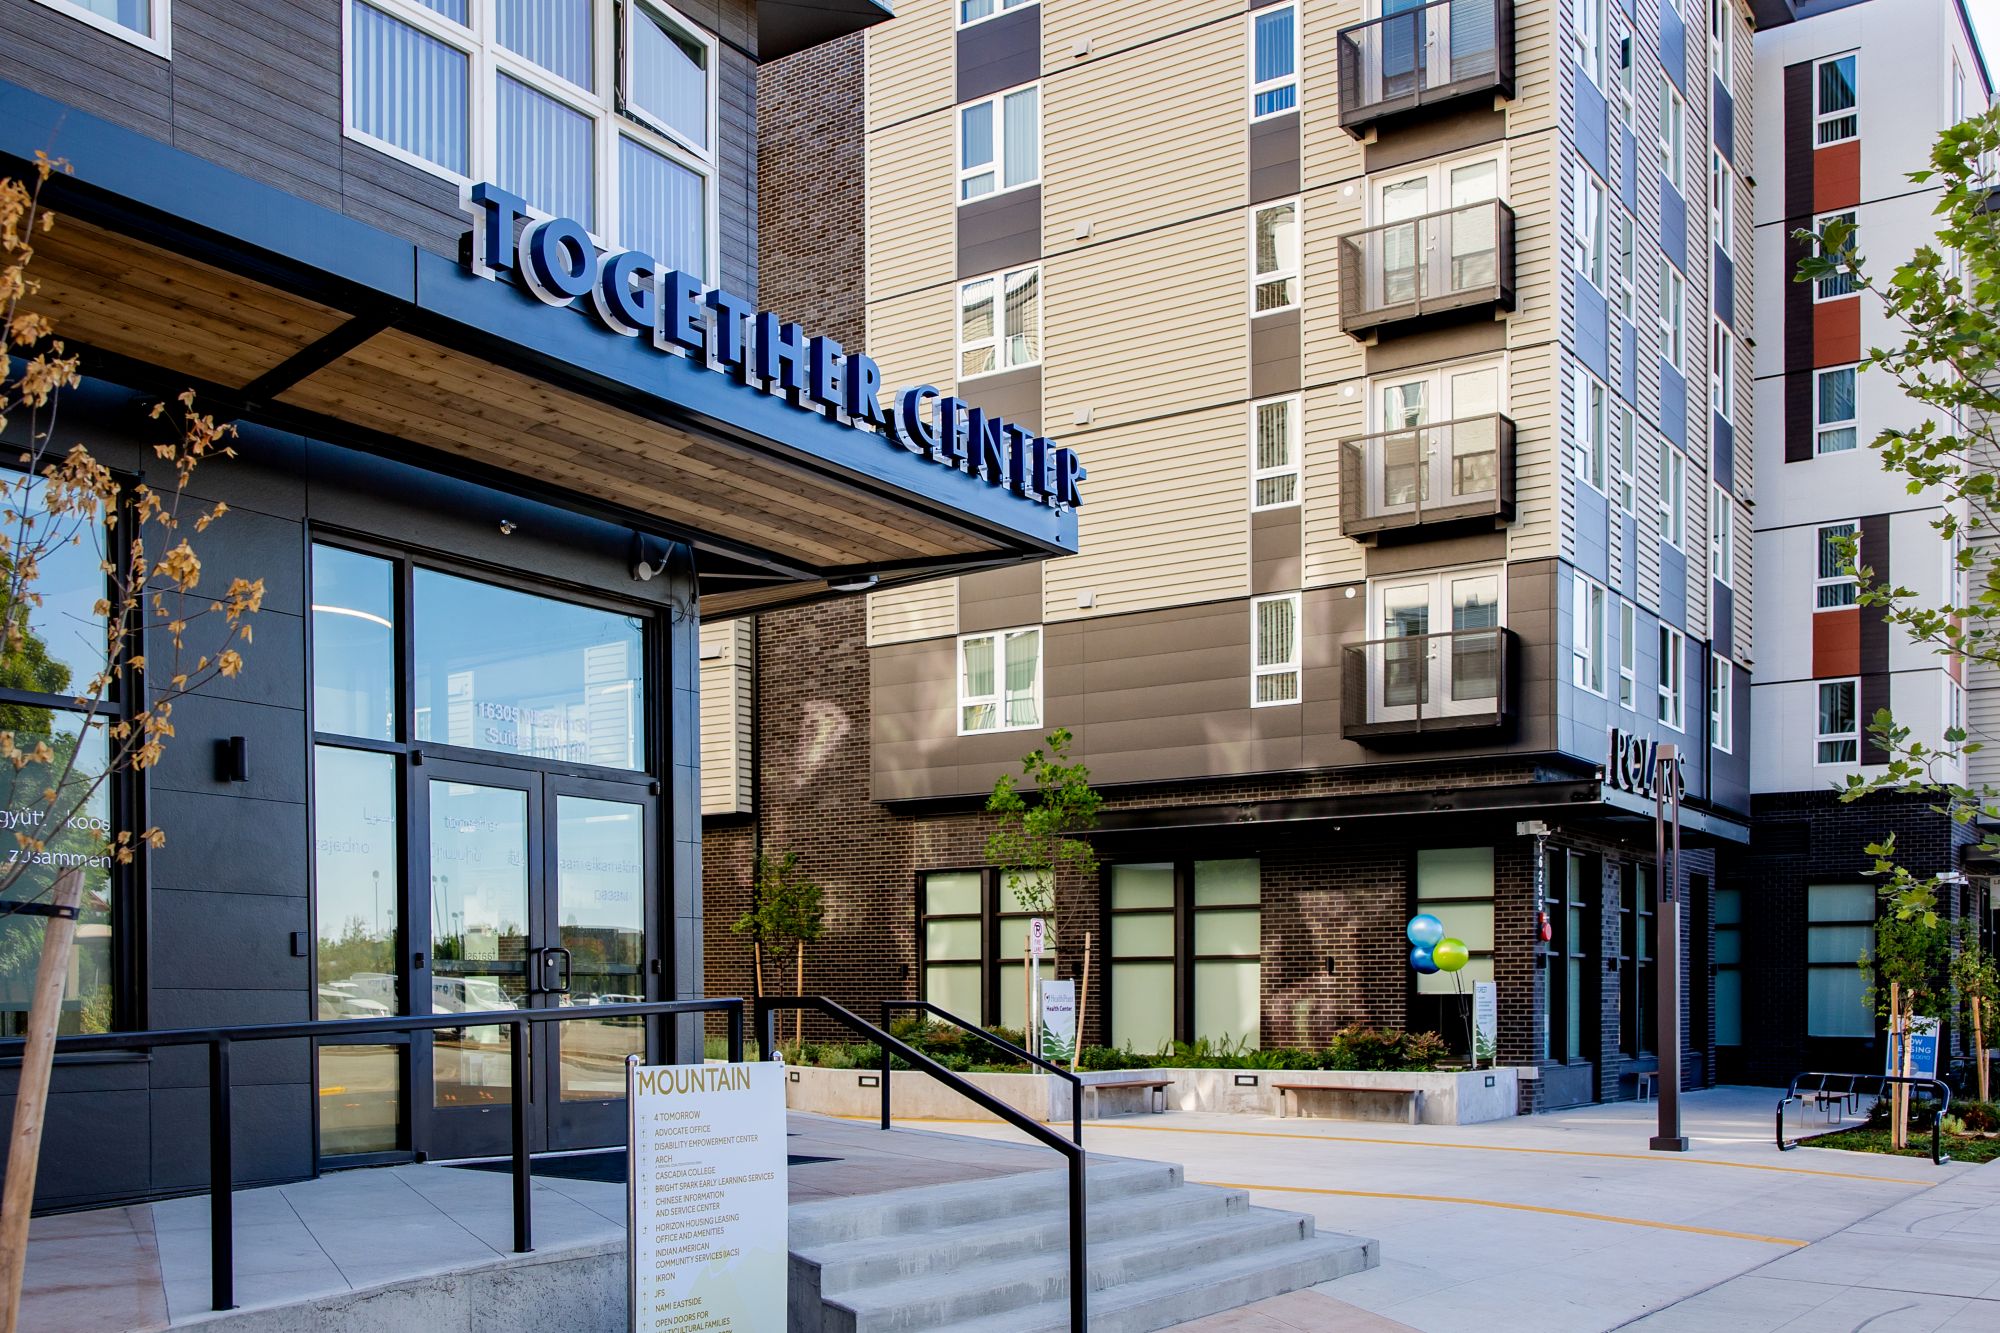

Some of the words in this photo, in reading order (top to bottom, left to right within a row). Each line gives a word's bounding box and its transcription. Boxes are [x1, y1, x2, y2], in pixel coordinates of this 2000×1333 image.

[462, 180, 885, 428] TOGETHER
[897, 384, 1087, 507] CENTER
[67, 810, 111, 830] koos
[638, 1066, 751, 1096] MOUNTAIN
[660, 1111, 701, 1121] TOMORROW
[655, 1127, 688, 1137] ADVOCATE
[690, 1125, 711, 1134] OFFICE
[654, 1141, 688, 1151] DISABILITY
[688, 1136, 734, 1148] EMPOWERMENT
[736, 1134, 758, 1143] CENTER
[655, 1155, 672, 1164] ARCH
[655, 1168, 687, 1180] CASCADIA
[688, 1166, 716, 1176] COLLEGE
[655, 1183, 678, 1193] BRIGHT
[680, 1182, 698, 1190] SPARK
[699, 1180, 717, 1188] EARLY
[718, 1175, 747, 1186] LEARNING
[748, 1172, 774, 1183] SERVICES
[655, 1196, 682, 1206] CHINESE
[683, 1191, 725, 1202] INFORMATION
[655, 1208, 670, 1218] AND
[670, 1205, 696, 1216] SERVICE
[696, 1202, 720, 1212] CENTER
[655, 1221, 685, 1232] HORIZON
[686, 1217, 714, 1228] HOUSING
[714, 1213, 740, 1224] LEASING
[655, 1234, 678, 1244] OFFICE
[679, 1232, 692, 1240] AND
[693, 1227, 724, 1238] AMENITIES
[655, 1246, 677, 1257] INDIAN
[679, 1242, 710, 1254] AMERICAN
[655, 1256, 694, 1269] COMMUNITY
[695, 1251, 722, 1263] SERVICES
[723, 1248, 740, 1258] (IACS)
[655, 1272, 676, 1282] IKRON
[654, 1289, 665, 1298] JFS
[655, 1302, 672, 1312] NAMI
[673, 1297, 702, 1309] EASTSIDE
[655, 1318, 672, 1328] OPEN
[674, 1313, 696, 1324] DOORS
[697, 1310, 709, 1319] FOR
[656, 1323, 704, 1333] TICULTURAL
[704, 1318, 730, 1330] FAMILIES
